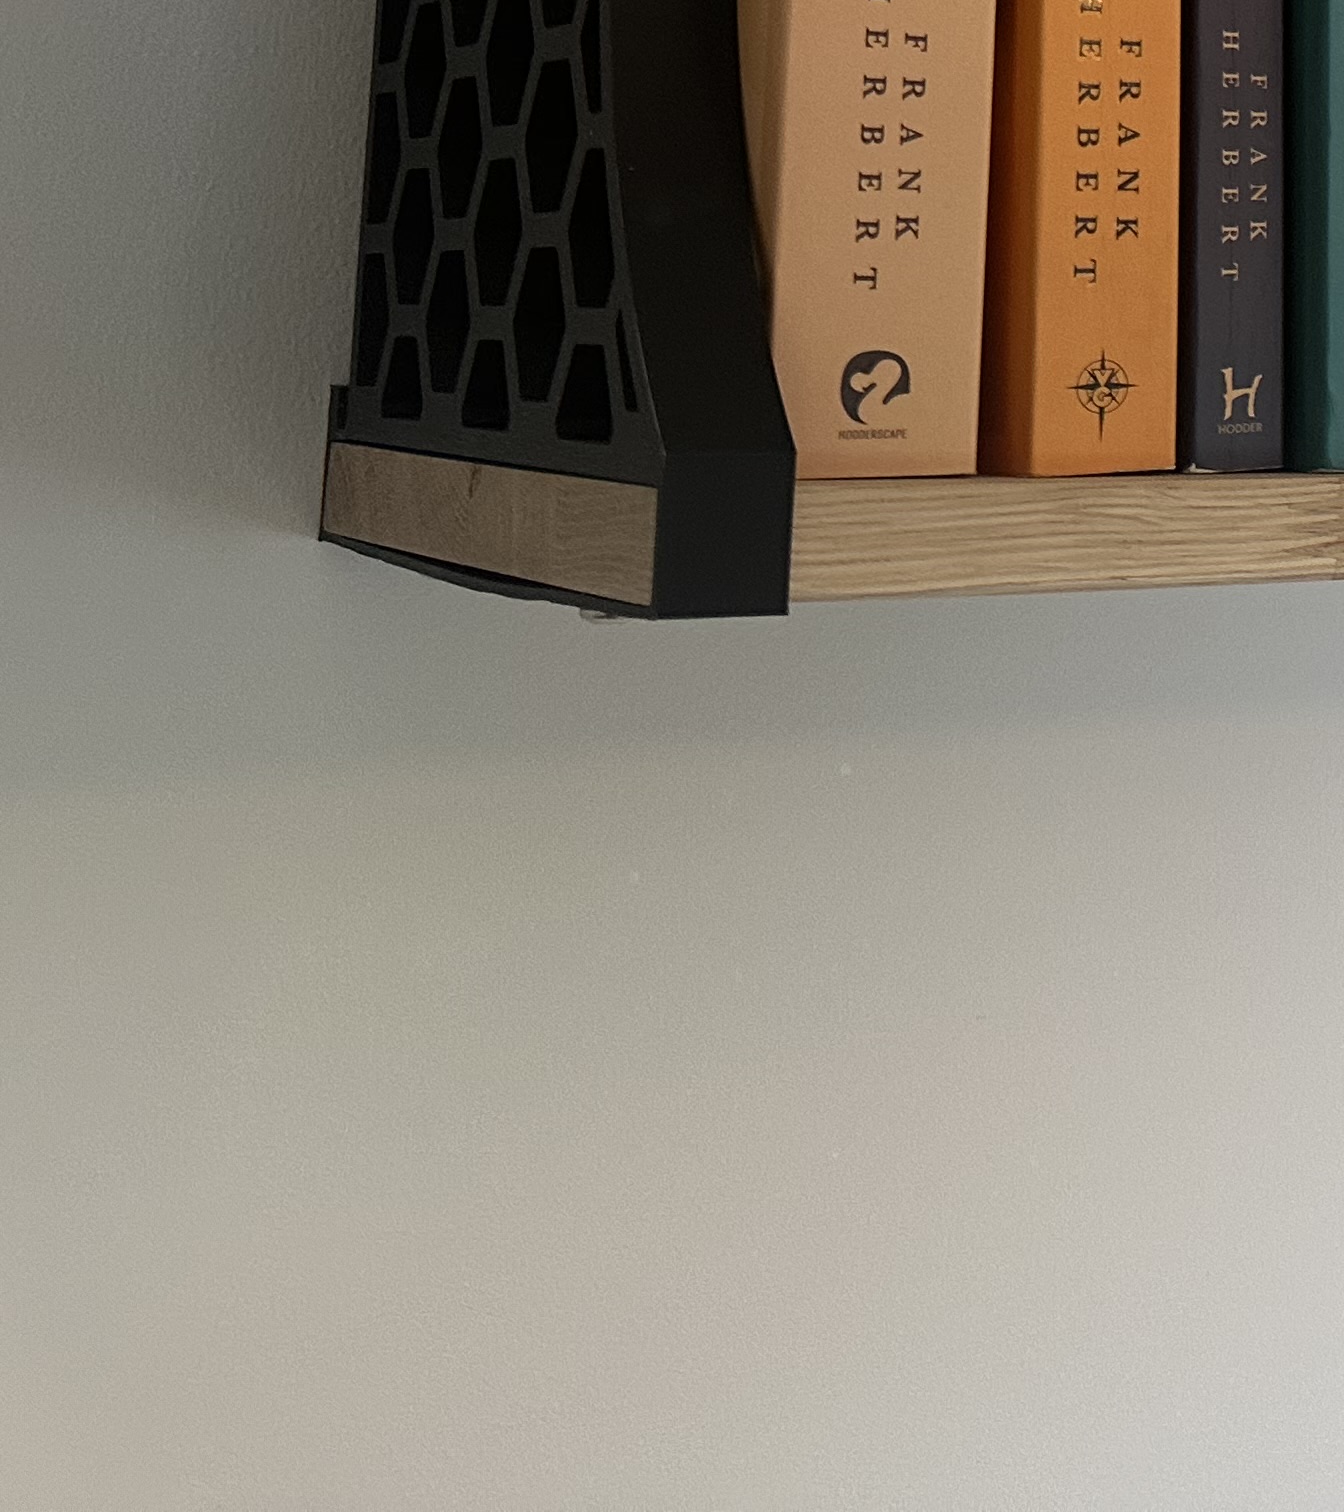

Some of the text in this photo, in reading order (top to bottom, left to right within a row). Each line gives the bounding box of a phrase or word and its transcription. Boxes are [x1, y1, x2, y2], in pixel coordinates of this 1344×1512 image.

[895, 32, 928, 240] FRANK
[1116, 38, 1142, 239] FRANK
[1221, 30, 1240, 281] HERBERT
[1250, 74, 1268, 240] FRANK
[1218, 421, 1263, 435] HODDER
